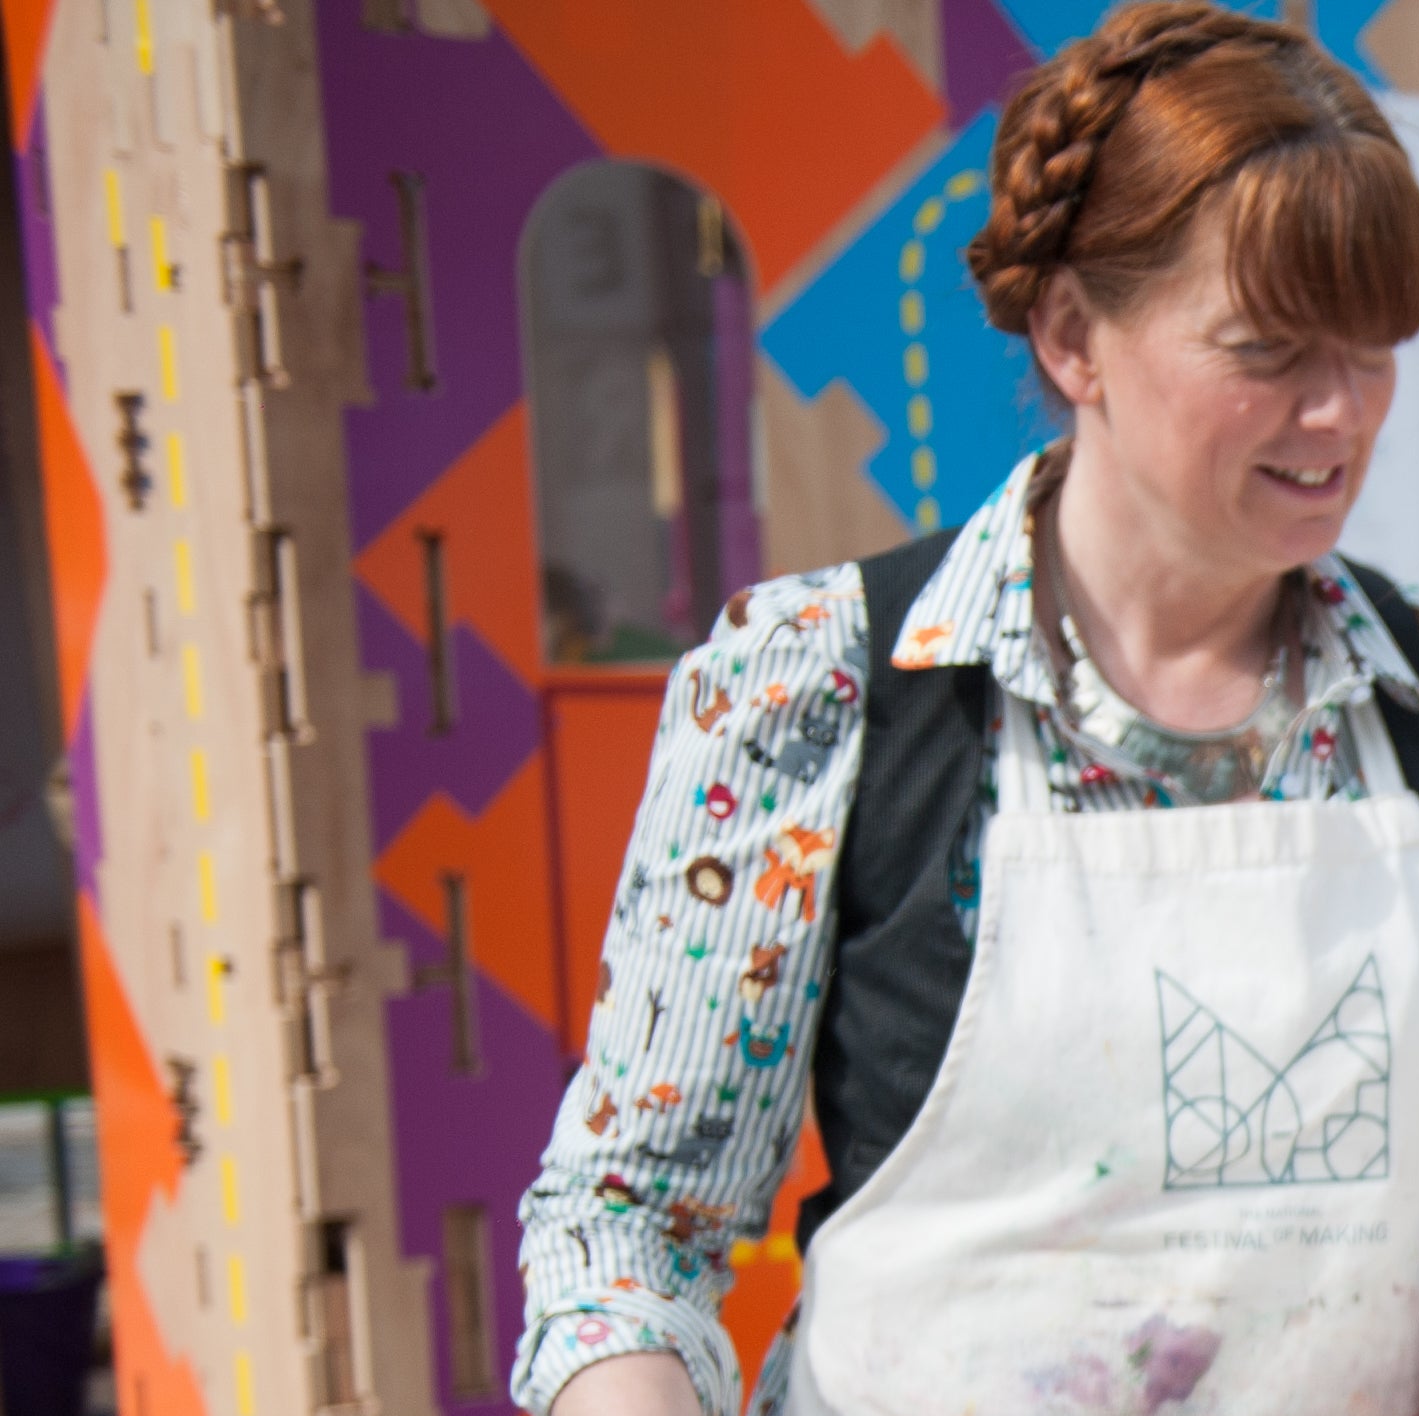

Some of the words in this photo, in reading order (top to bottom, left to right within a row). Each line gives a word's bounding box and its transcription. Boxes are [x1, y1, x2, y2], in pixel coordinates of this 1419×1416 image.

[1162, 1229, 1267, 1251] FESTIVAL
[1272, 1226, 1295, 1244] OF
[1299, 1220, 1388, 1247] MAKING
